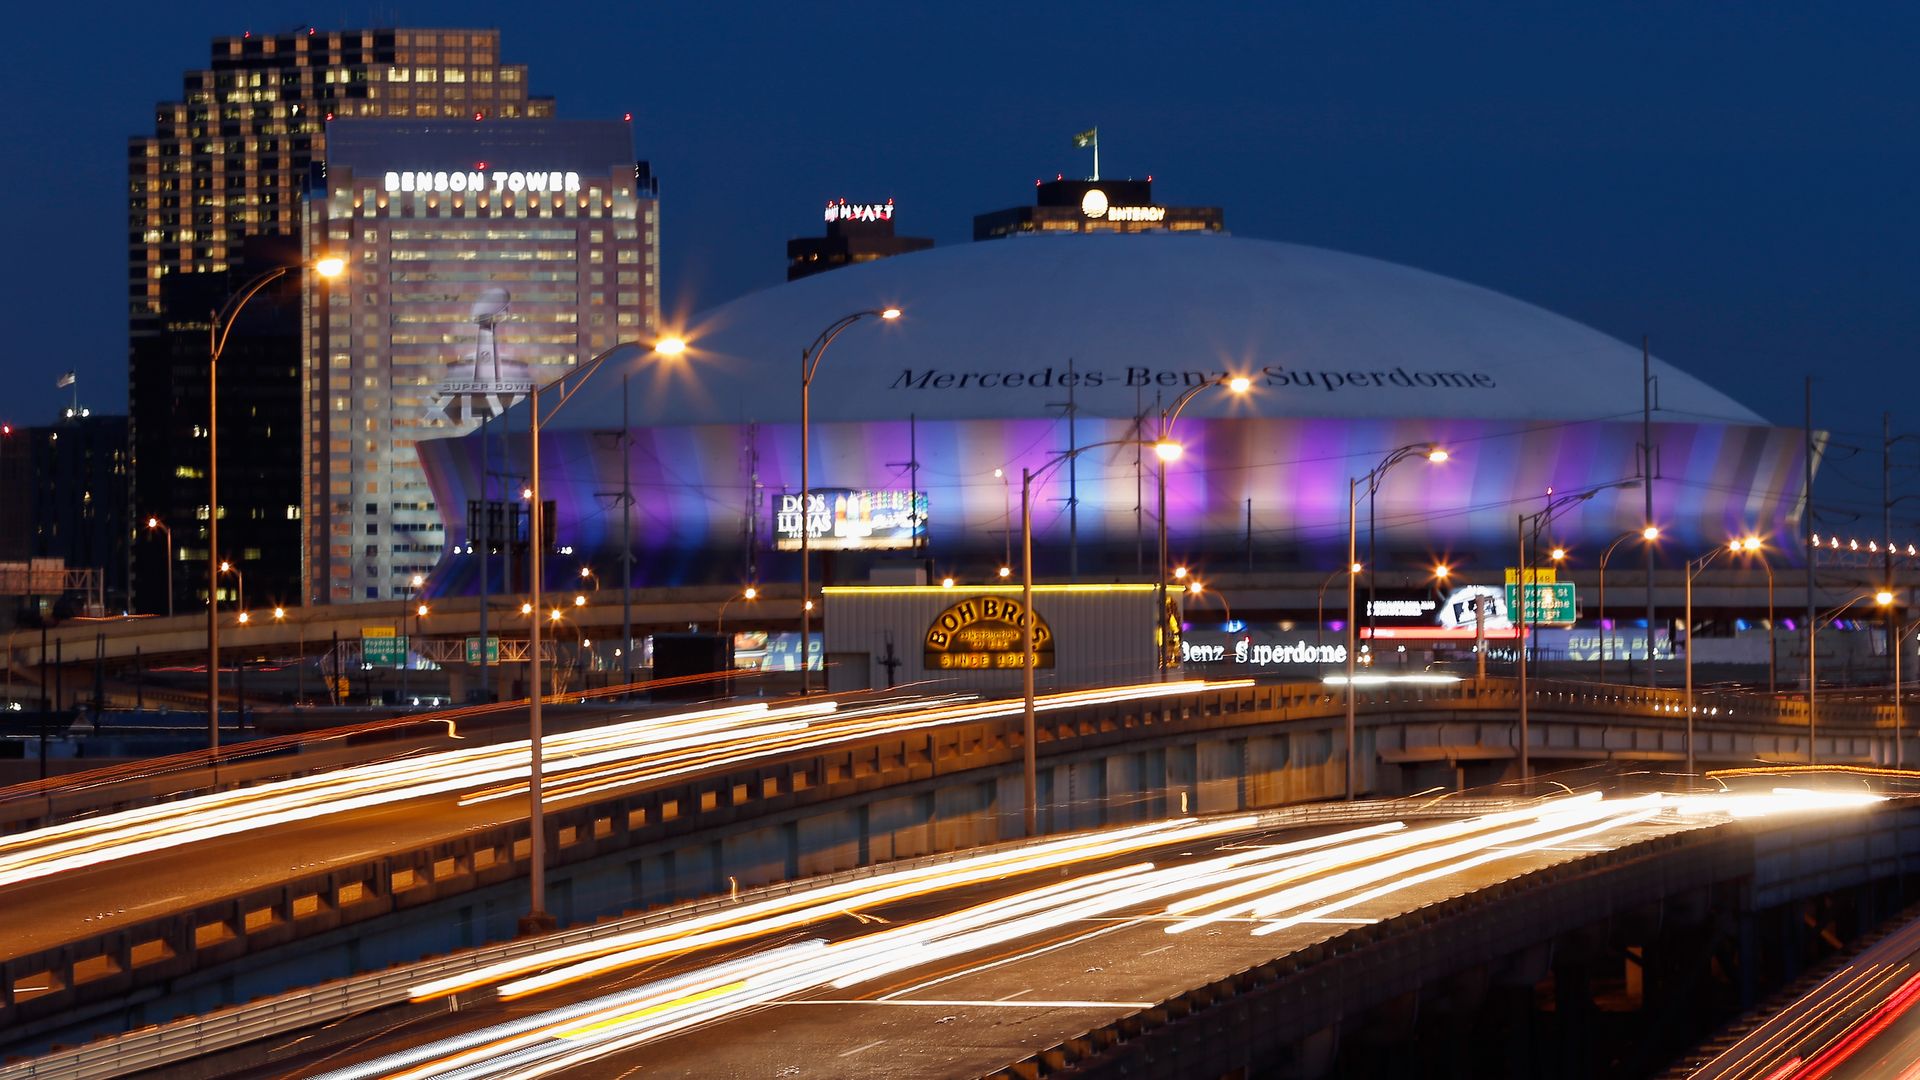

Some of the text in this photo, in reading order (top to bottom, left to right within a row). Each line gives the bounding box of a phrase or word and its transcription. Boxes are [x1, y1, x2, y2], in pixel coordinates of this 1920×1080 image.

[385, 171, 580, 192] BENSON TOWER
[840, 205, 894, 222] HYATT
[888, 365, 1496, 391] Mercedes-Benz Superdome
[443, 383, 531, 391] SUPER BOWL
[782, 494, 825, 513] DOS
[1558, 588, 1568, 597] St
[1512, 600, 1570, 609] Sperdome
[929, 602, 975, 648] BOH
[1569, 638, 1625, 650] SUPER
[941, 653, 989, 668] SINCE
[1236, 640, 1347, 666] Superdome
